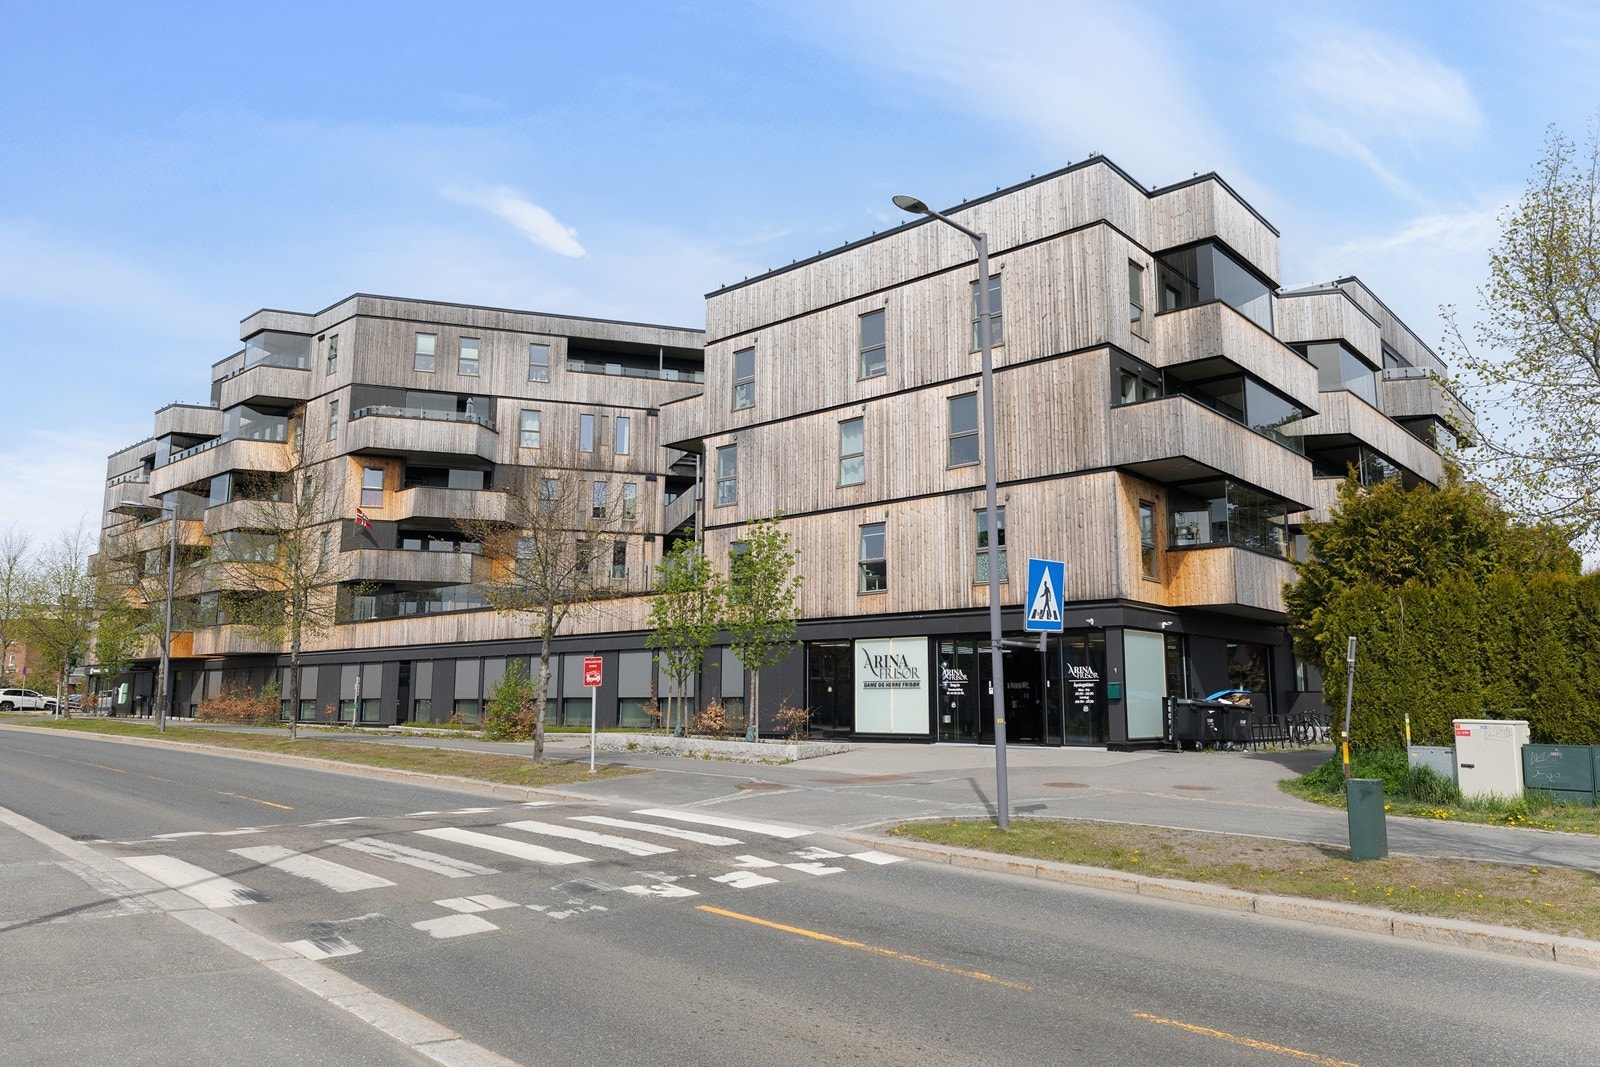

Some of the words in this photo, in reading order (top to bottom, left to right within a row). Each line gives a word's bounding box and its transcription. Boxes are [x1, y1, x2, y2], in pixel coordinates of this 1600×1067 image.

[862, 648, 909, 677] ARINA
[879, 667, 920, 680] FRISØR
[941, 666, 963, 679] ARINA
[1067, 663, 1094, 678] ARINA
